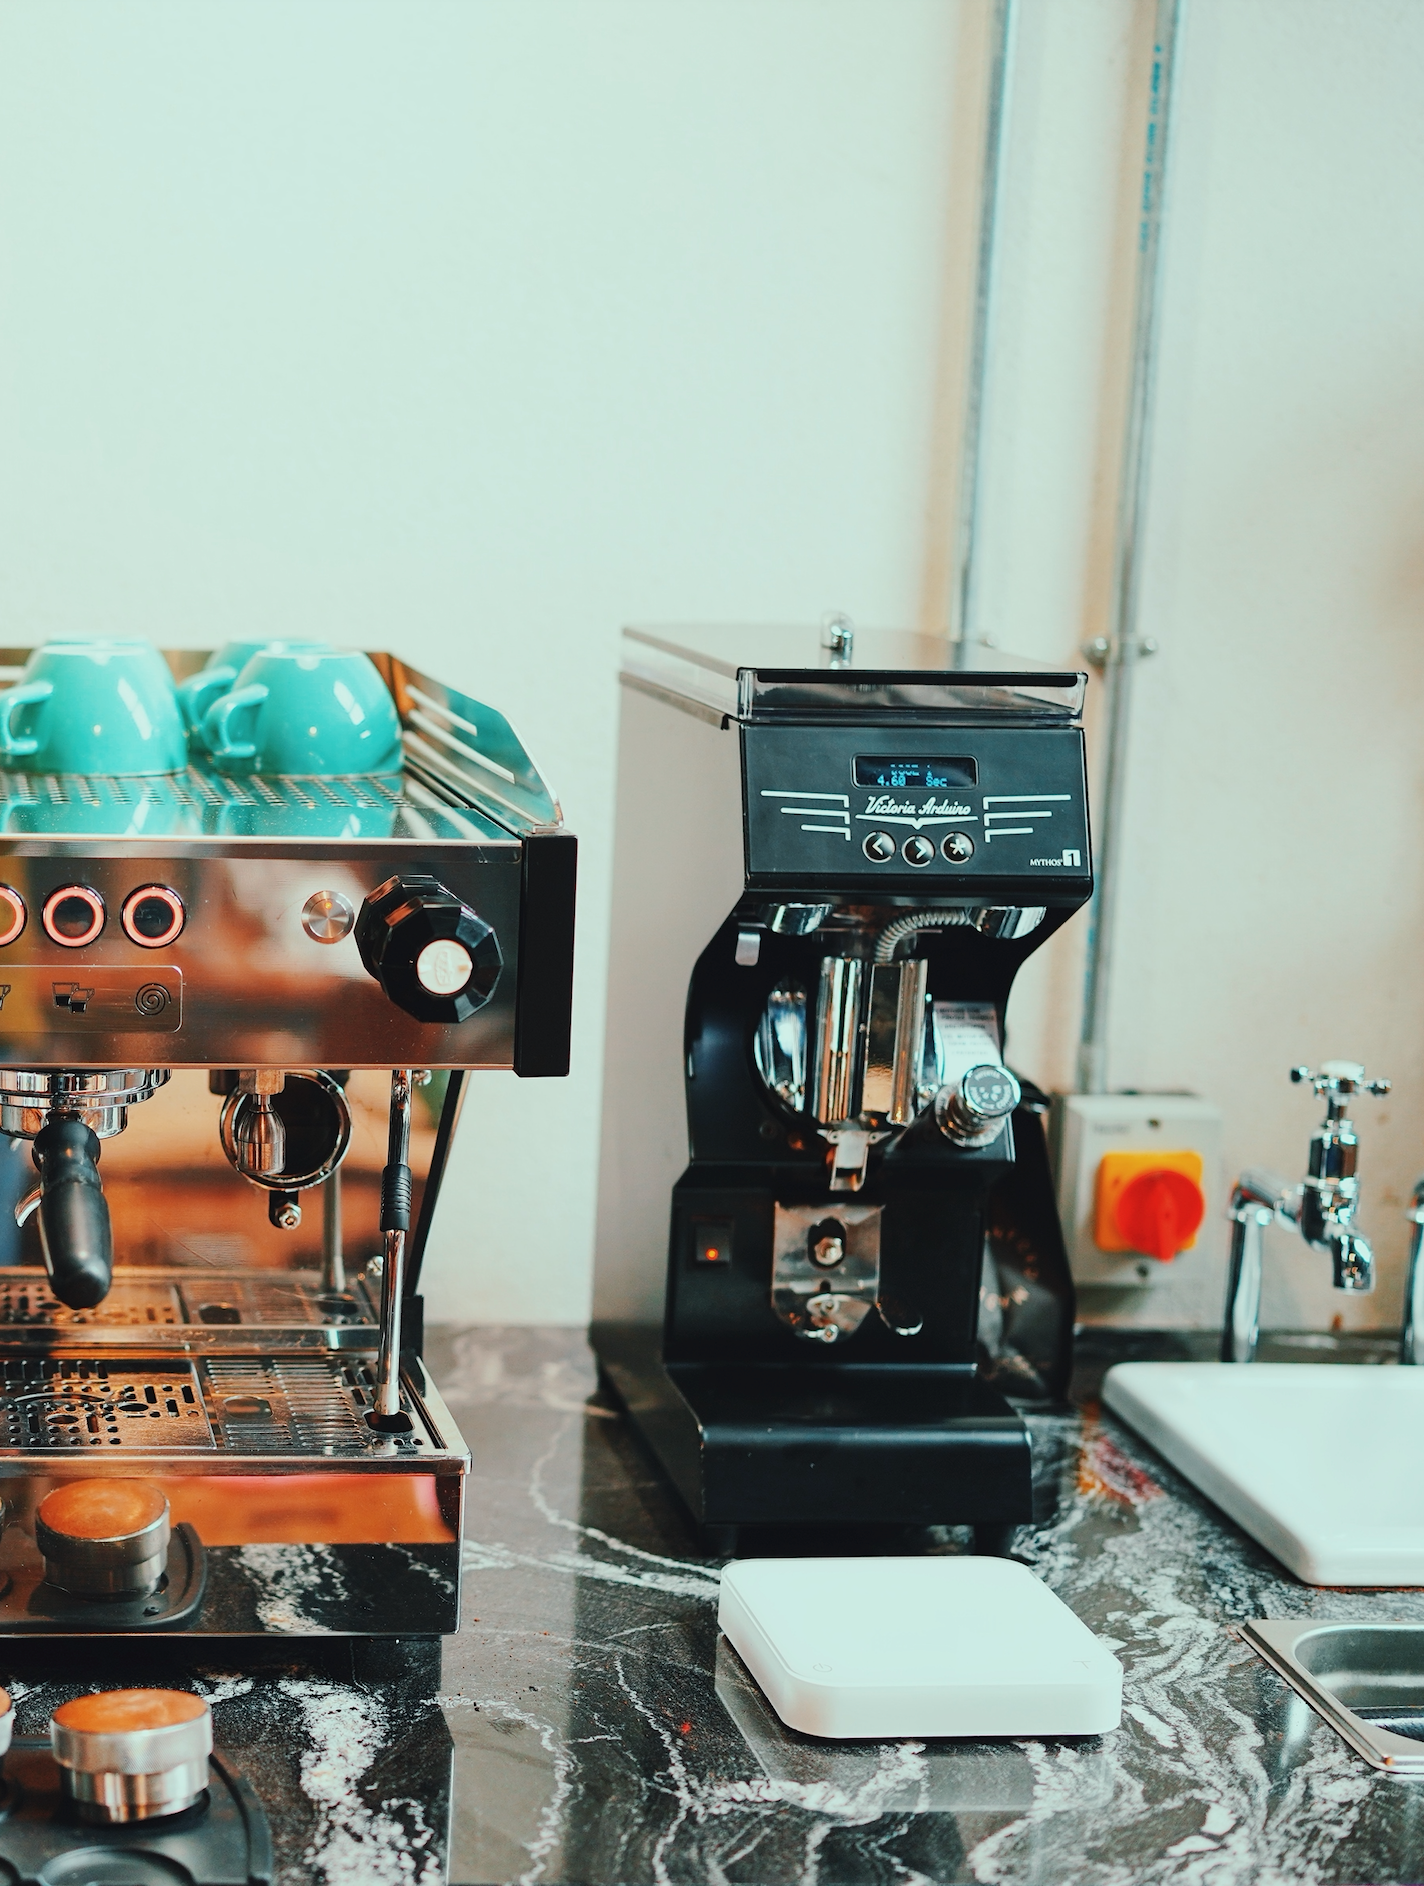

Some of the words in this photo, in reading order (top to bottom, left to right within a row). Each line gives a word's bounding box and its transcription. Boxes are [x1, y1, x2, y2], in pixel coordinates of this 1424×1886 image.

[925, 775, 948, 787] Sec
[864, 795, 916, 815] Victoria
[917, 797, 972, 816] Arduino
[1029, 858, 1062, 867] MYTHOS
